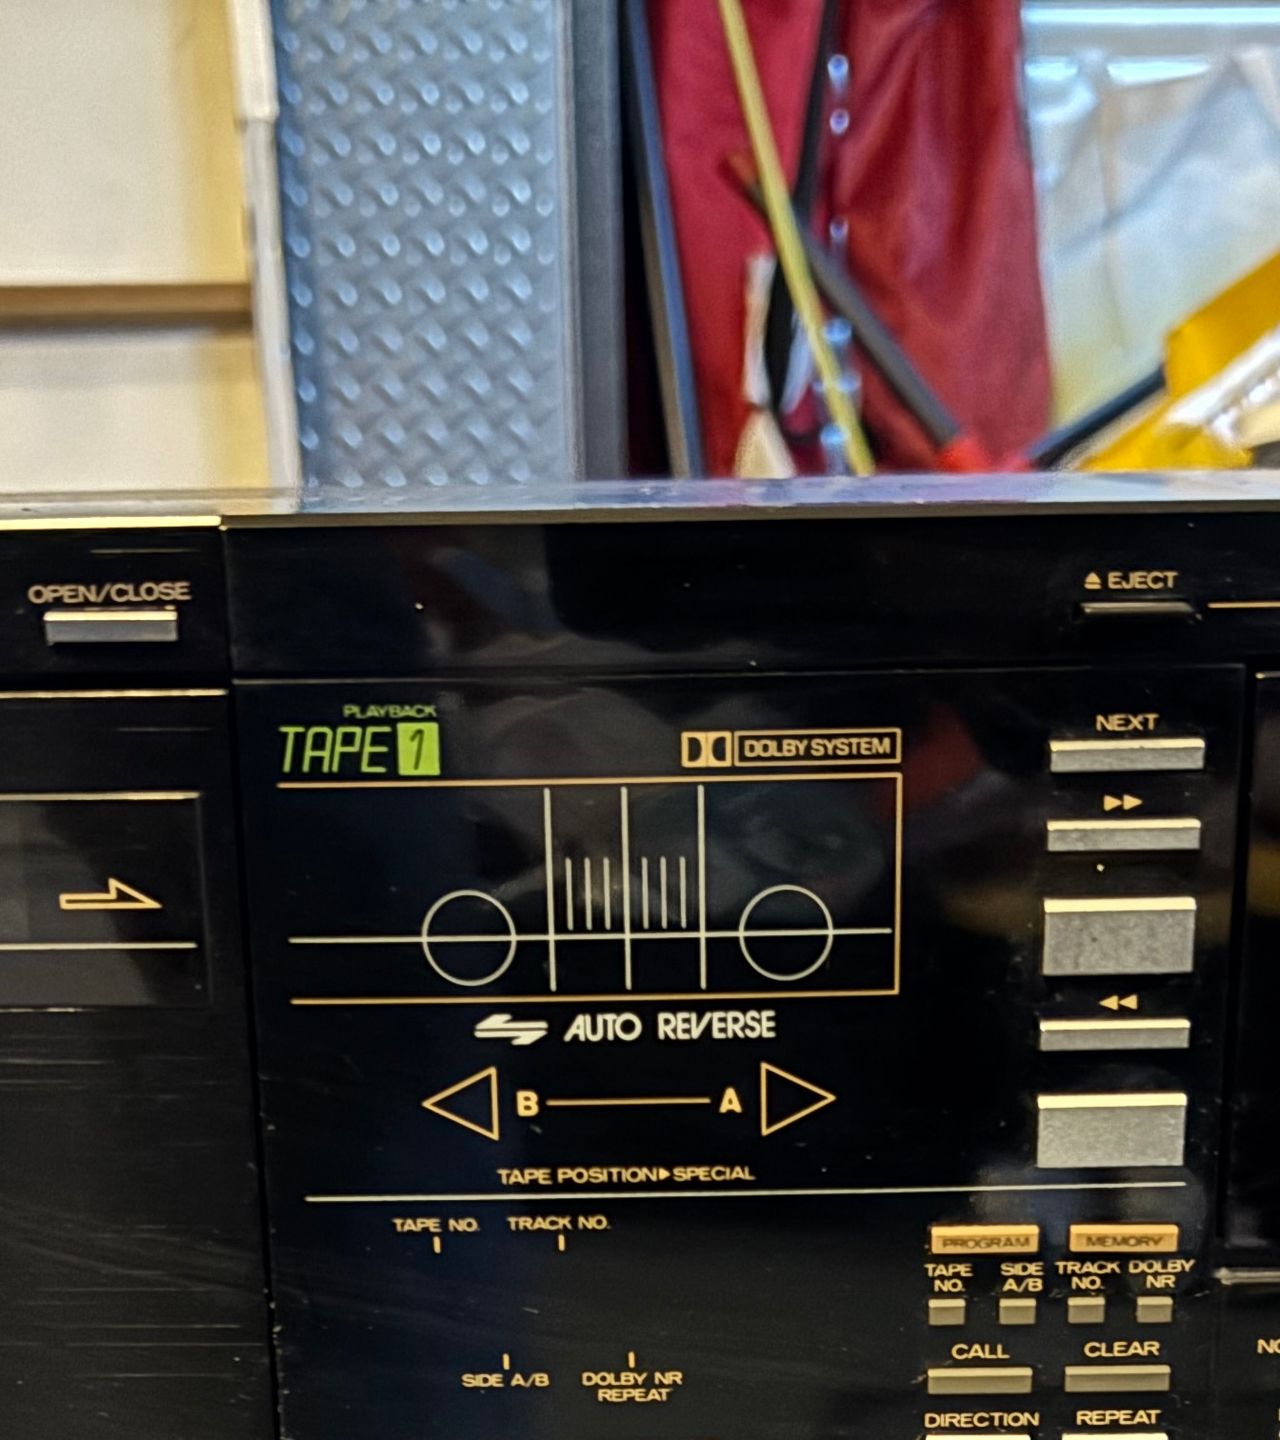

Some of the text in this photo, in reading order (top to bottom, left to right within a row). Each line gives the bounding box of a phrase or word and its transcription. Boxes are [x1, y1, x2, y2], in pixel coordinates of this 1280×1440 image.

[1108, 571, 1179, 589] EJECT
[28, 582, 191, 604] OPEN/CLOSE
[344, 703, 437, 719] PLAYBACK
[1096, 712, 1160, 731] NEXT
[279, 726, 392, 773] TAPE
[744, 737, 891, 756] DOLBY SYSTEM
[564, 1010, 776, 1042] AUTO REVERSE
[516, 1091, 540, 1117] B
[719, 1088, 743, 1114] A
[497, 1165, 756, 1185] TAPE POSITION SPECIAL
[393, 1217, 480, 1233] TAPE NO.
[507, 1215, 611, 1230] TRACK NO.
[941, 1236, 1030, 1249] PROGRAM
[1086, 1235, 1164, 1247] MEMORY
[924, 1263, 973, 1277] TAPE
[1000, 1262, 1044, 1276] SIDE
[1054, 1260, 1120, 1274] TRACK
[1128, 1259, 1195, 1273] DOLBY
[933, 1279, 966, 1292] NO.
[1002, 1278, 1044, 1292] A/B
[1071, 1276, 1104, 1290] NO.
[1146, 1275, 1176, 1289] NR
[951, 1344, 1010, 1360] CALL
[1083, 1341, 1160, 1357] CLEAR
[461, 1373, 549, 1387] SIDE A/B
[581, 1371, 683, 1387] DOLBY NR
[596, 1388, 671, 1403] REPEAT
[924, 1412, 1040, 1427] DIRECTION
[1076, 1410, 1162, 1425] REPEAT
